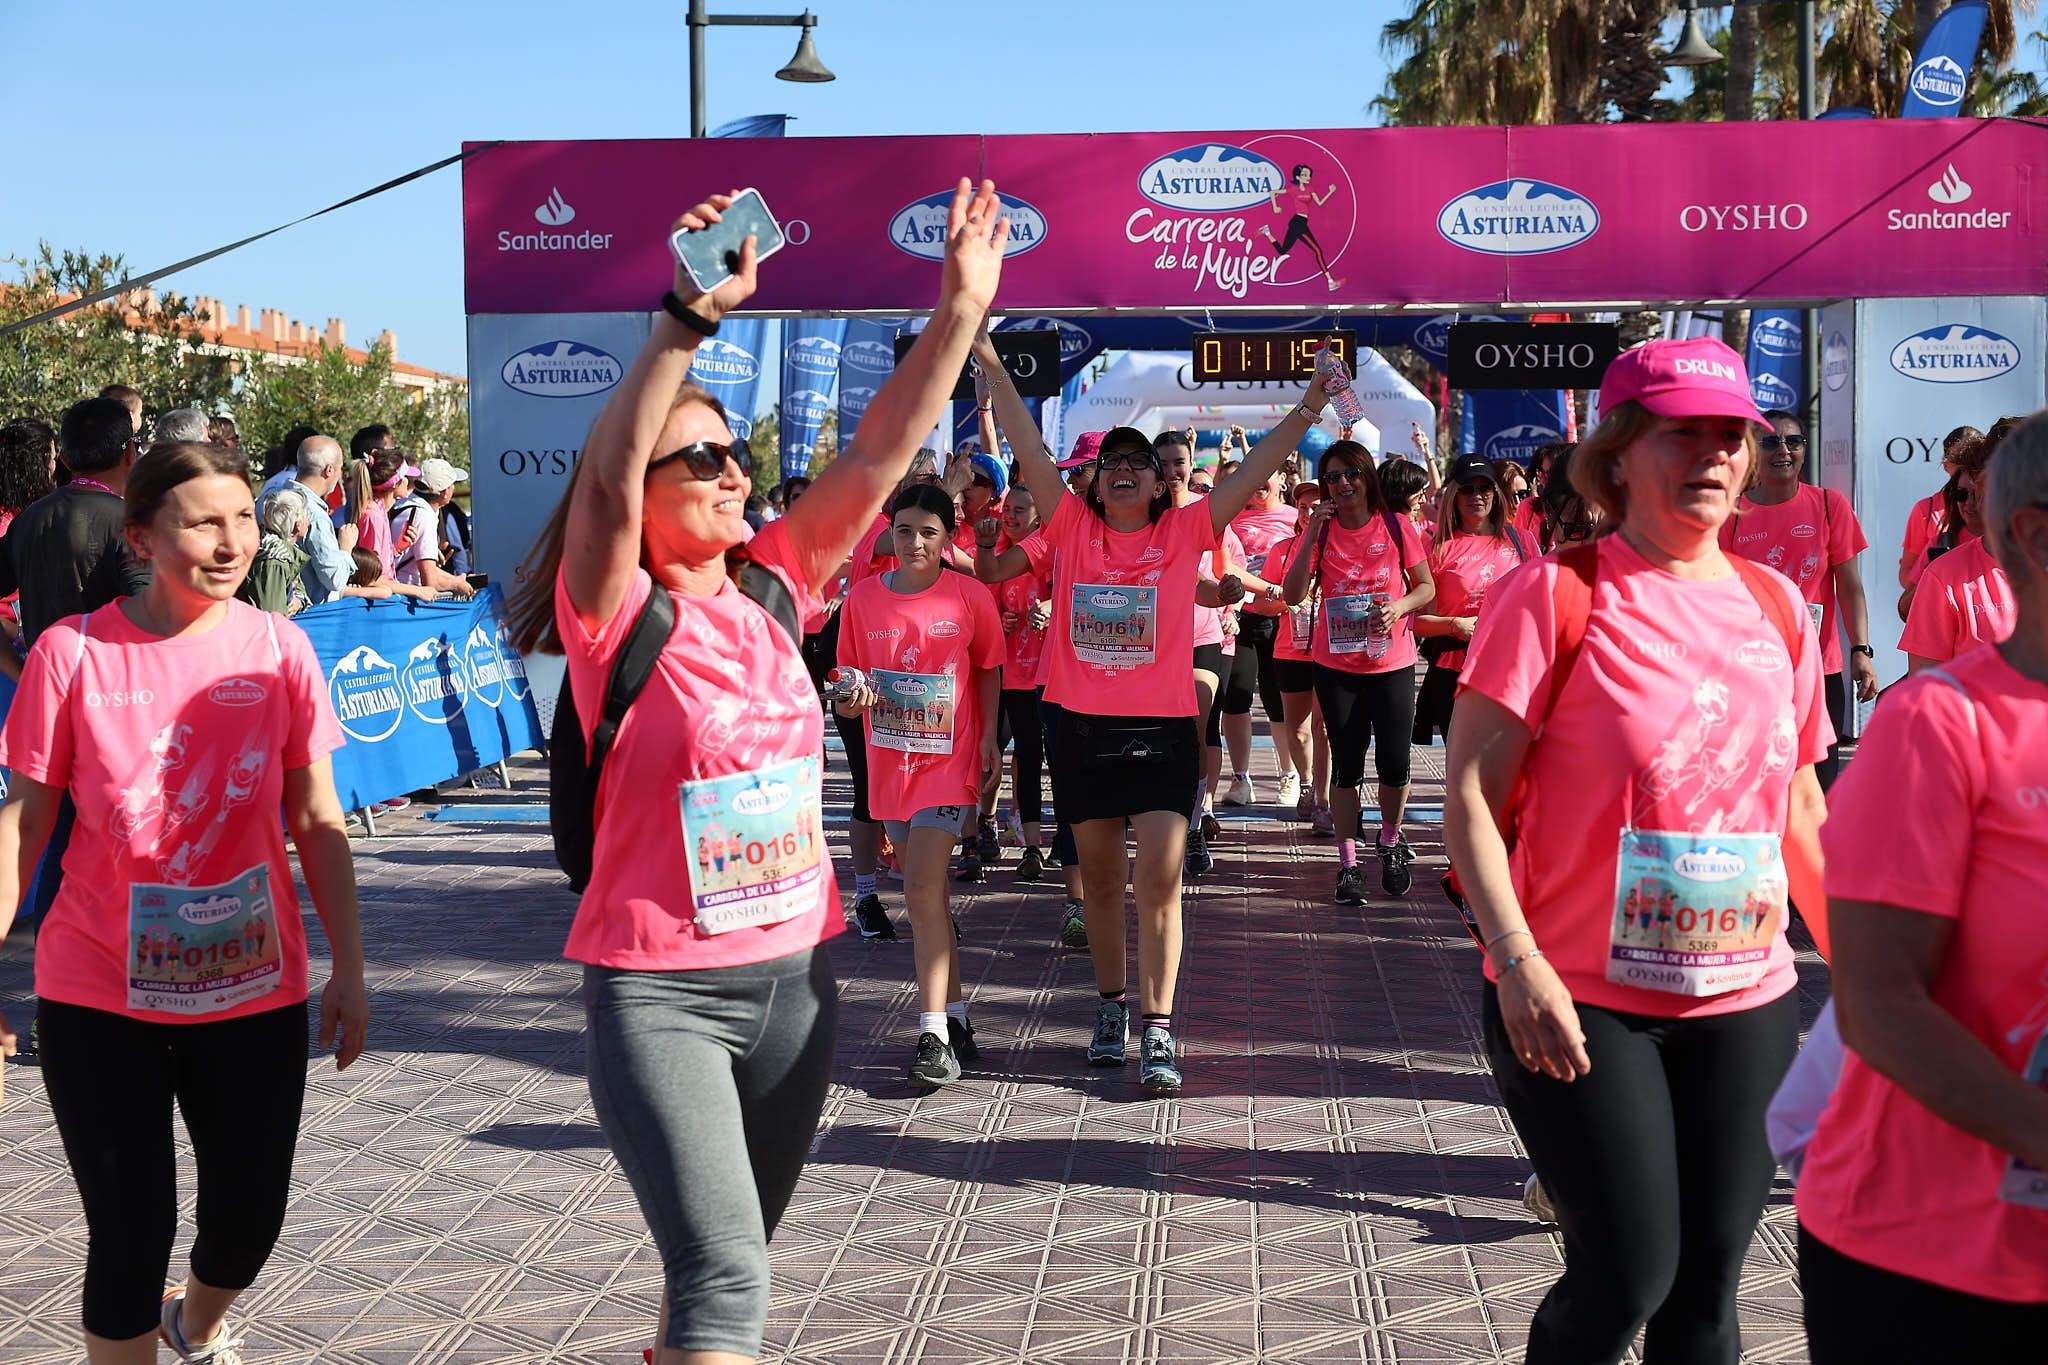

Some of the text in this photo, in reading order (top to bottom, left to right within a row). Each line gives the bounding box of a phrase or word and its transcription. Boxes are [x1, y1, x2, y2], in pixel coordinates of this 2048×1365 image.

[1915, 71, 1962, 97] ASTURIANA
[1150, 168, 1273, 195] ASTURIANA
[1125, 207, 1247, 244] Carrera
[1450, 207, 1587, 236] ASTURIANA
[1679, 203, 1808, 232] OYSHO
[1887, 207, 2012, 231] Santander
[498, 229, 613, 251] Santander
[1154, 239, 1291, 299] de la Mujer
[791, 347, 839, 369] ASTURIAN
[1475, 343, 1594, 368] OYSHO
[1899, 347, 2011, 369] ASTURIANA
[511, 362, 614, 385] ASTURIANA
[1674, 358, 1737, 382] DRUNI
[1089, 397, 1134, 407] OYSHO
[1737, 530, 1769, 544] OYSHO
[867, 628, 901, 640] OYSHO
[1094, 621, 1127, 635] 016
[408, 669, 465, 705] ASTURIANA
[85, 689, 155, 708] OYSHO
[337, 683, 401, 723] ASTURIANA
[894, 706, 926, 722] 016
[745, 832, 797, 865] 016
[1679, 859, 1742, 873] ASTURIANA
[760, 883, 773, 896] LA
[183, 902, 240, 920] ASTURIANA
[715, 903, 768, 924] OYSHO
[1675, 906, 1738, 933] 016
[183, 937, 241, 967] 016
[1688, 940, 1719, 952] 5369
[1682, 952, 1695, 965] LA
[137, 963, 274, 993] CARRERA DE LA MUJER VALENCIA
[1627, 967, 1686, 984] OYSHO
[144, 994, 197, 1008] OYSHO
